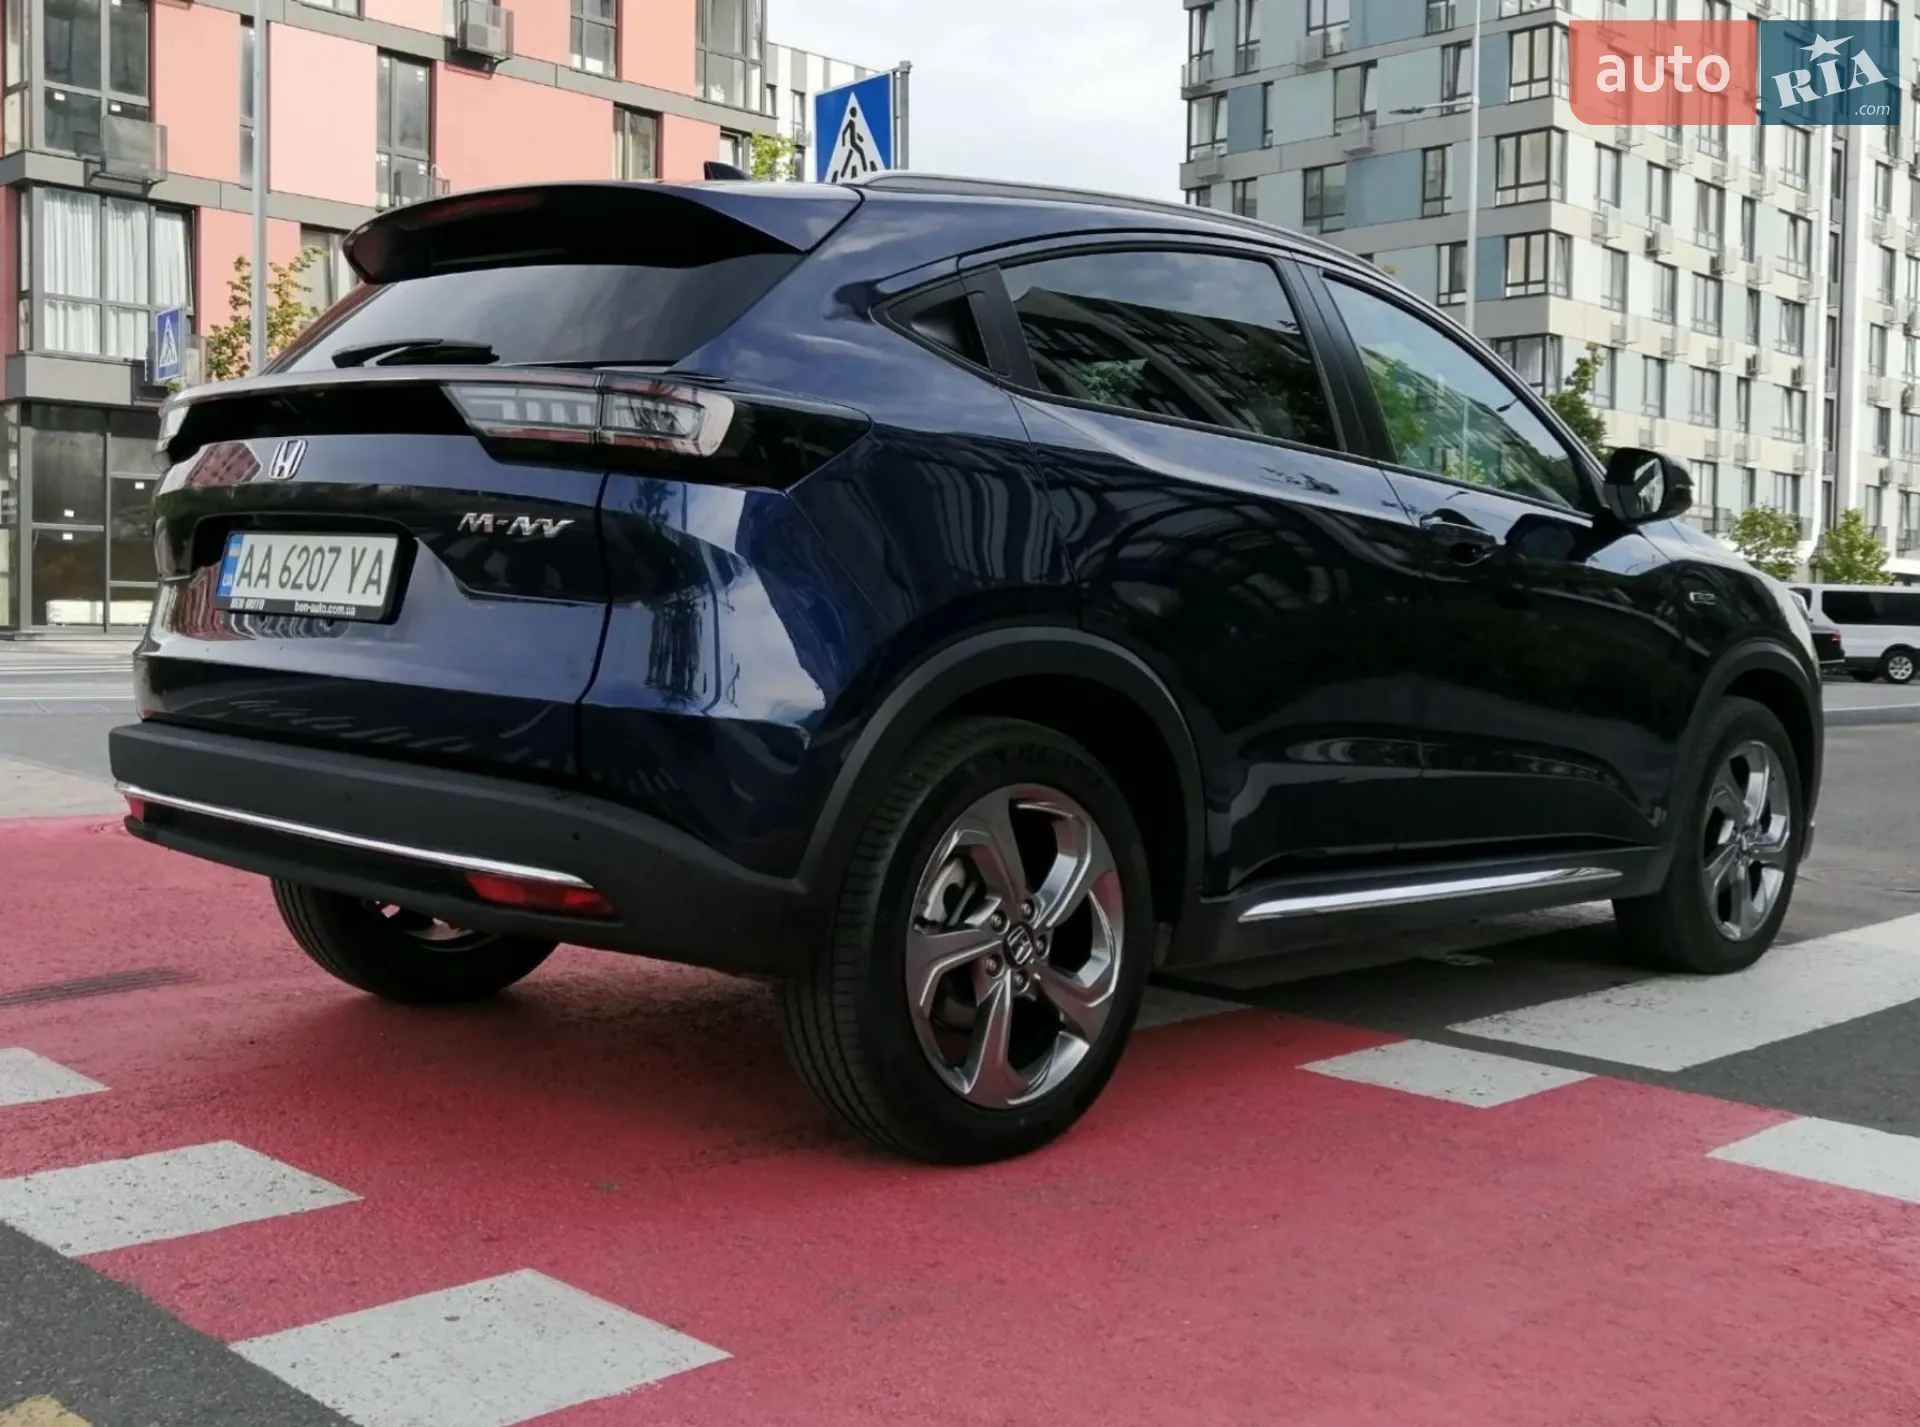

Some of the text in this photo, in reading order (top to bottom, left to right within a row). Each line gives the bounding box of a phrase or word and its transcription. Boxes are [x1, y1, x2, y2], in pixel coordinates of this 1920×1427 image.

[236, 544, 384, 595] AA 6207 YA
[294, 600, 356, 616] ben-auto.com.ua
